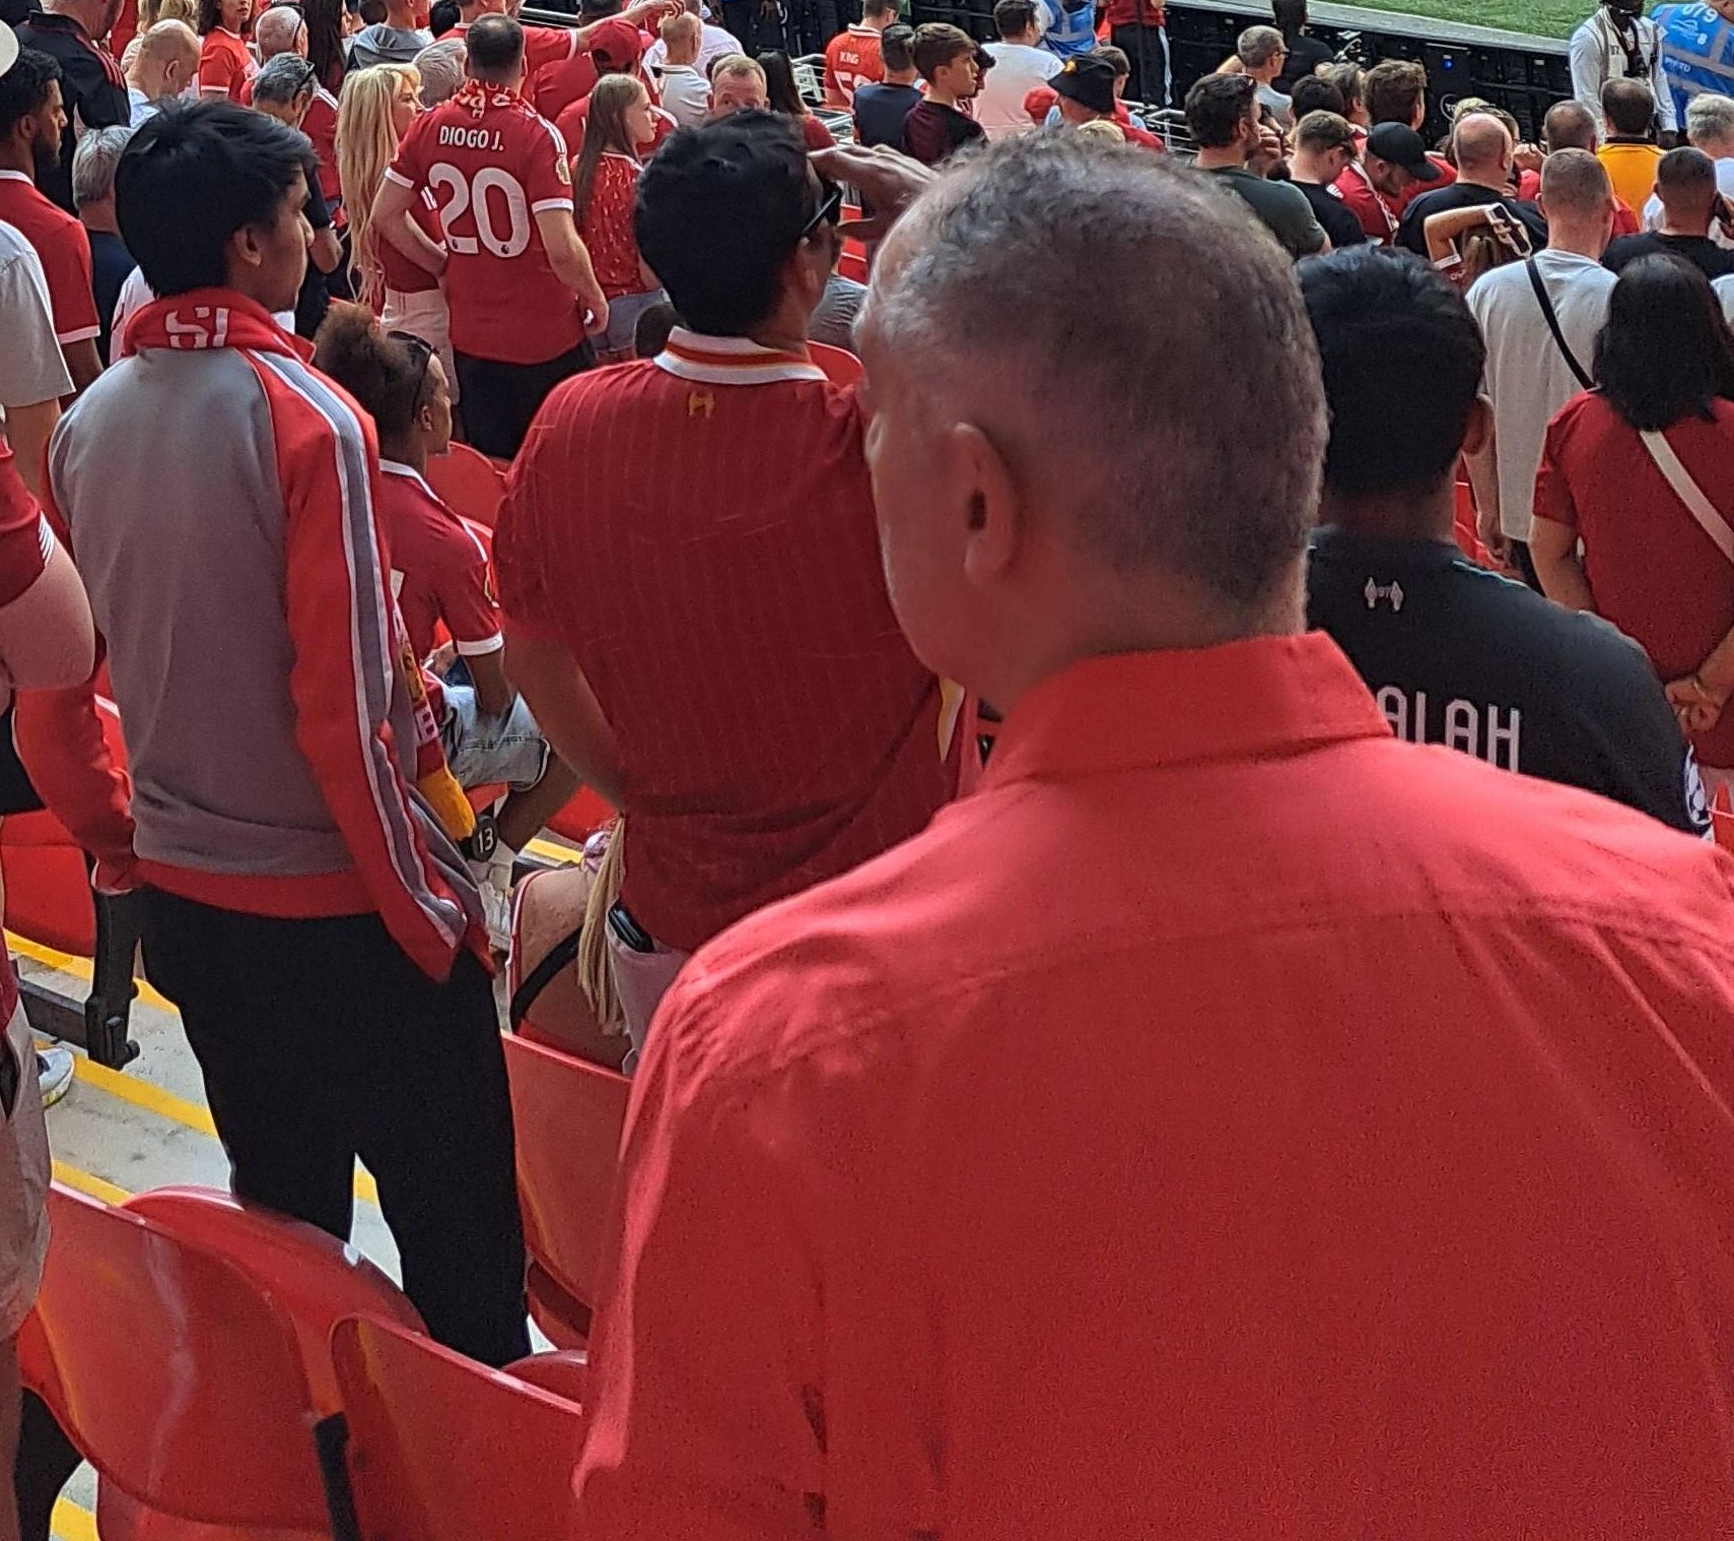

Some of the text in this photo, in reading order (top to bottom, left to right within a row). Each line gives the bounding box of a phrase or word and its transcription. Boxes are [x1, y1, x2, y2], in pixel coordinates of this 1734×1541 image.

[439, 125, 505, 152] DIOGO J.
[428, 162, 531, 258] 20
[478, 828, 494, 853] 13
